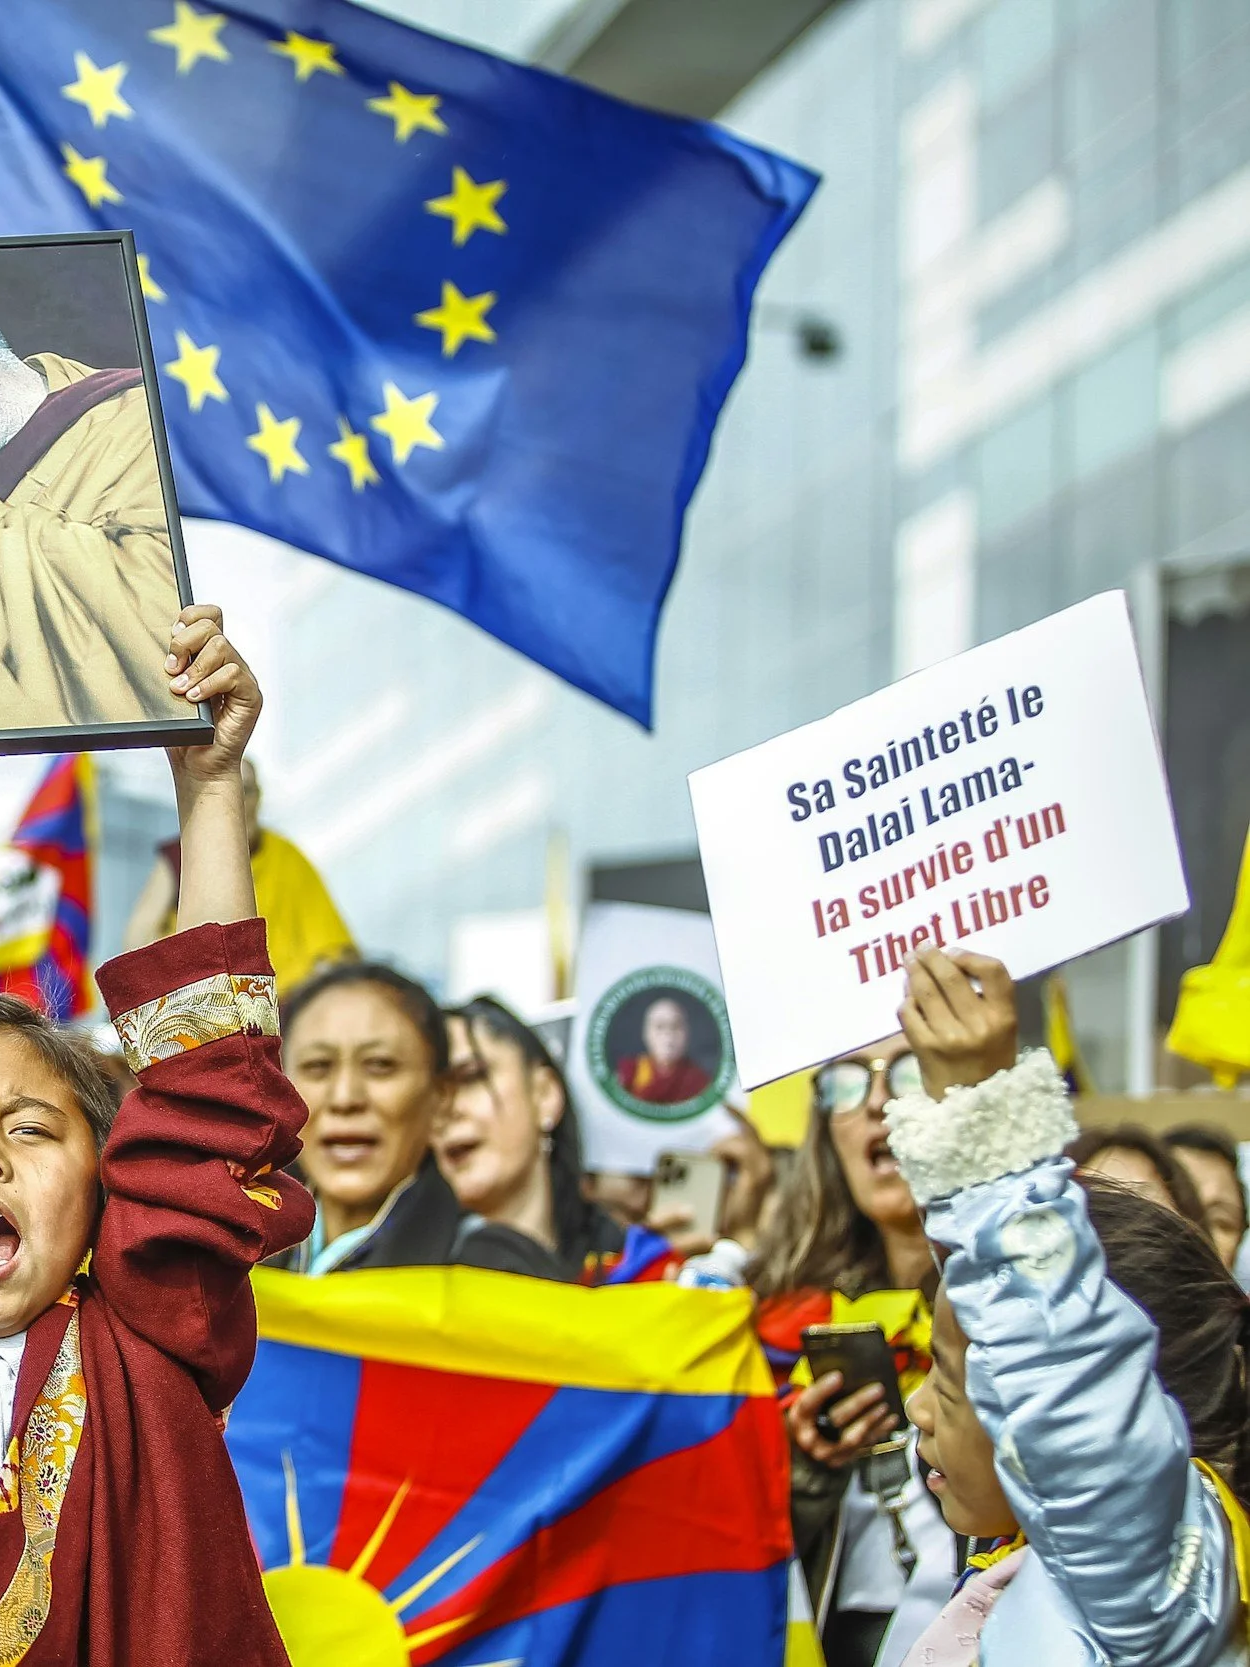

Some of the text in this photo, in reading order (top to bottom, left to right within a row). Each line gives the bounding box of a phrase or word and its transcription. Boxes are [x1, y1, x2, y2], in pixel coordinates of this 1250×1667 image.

[786, 684, 1044, 822] Sa Sainteté le
[817, 756, 1036, 874] Dalai Lama-
[812, 801, 1067, 938] la survie d'un
[849, 874, 1050, 984] Tibet Libre
